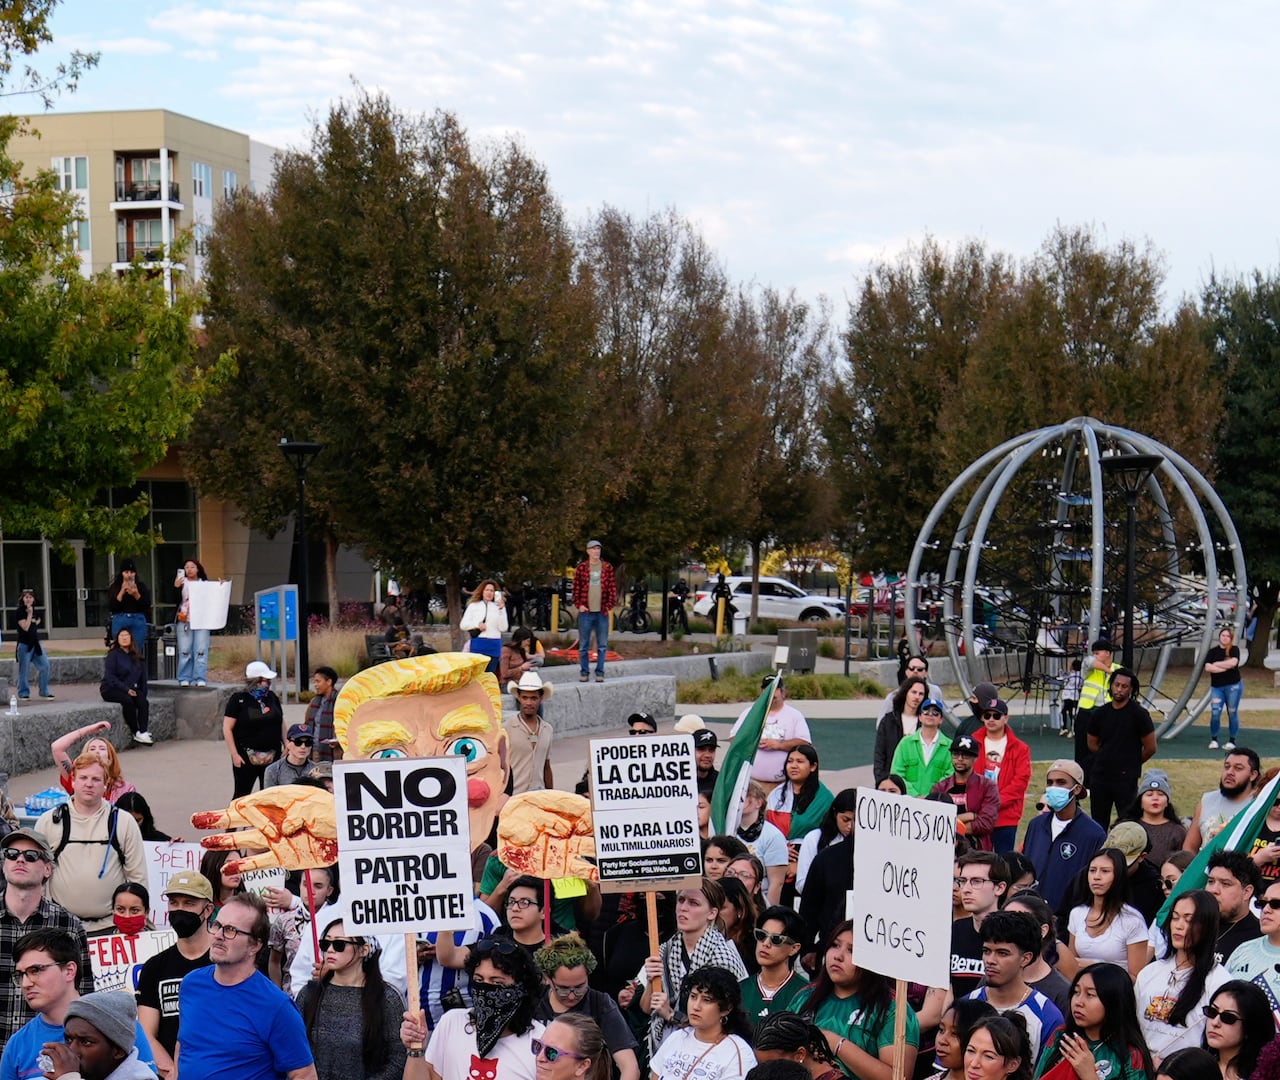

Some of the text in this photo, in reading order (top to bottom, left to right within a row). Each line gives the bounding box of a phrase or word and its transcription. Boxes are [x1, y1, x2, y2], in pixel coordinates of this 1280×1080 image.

[596, 742, 690, 764] ¡PODER PARA
[597, 761, 691, 785] LA CLASE
[344, 767, 457, 811] NO
[598, 784, 693, 801] TRABAJADORA,
[347, 809, 459, 841] BORDER
[600, 820, 693, 839] NO PARA LOS
[857, 795, 958, 845] COMPASSION
[601, 838, 694, 853] MULTIMILLONARIOS!
[354, 852, 457, 885] PATROL
[602, 864, 679, 876] Liberation PSLWeb.org
[628, 858, 657, 867] Socialism
[395, 883, 419, 896] IN
[882, 861, 920, 900] OVER
[351, 893, 465, 925] CHARLOTTE!
[864, 913, 926, 958] CAGES
